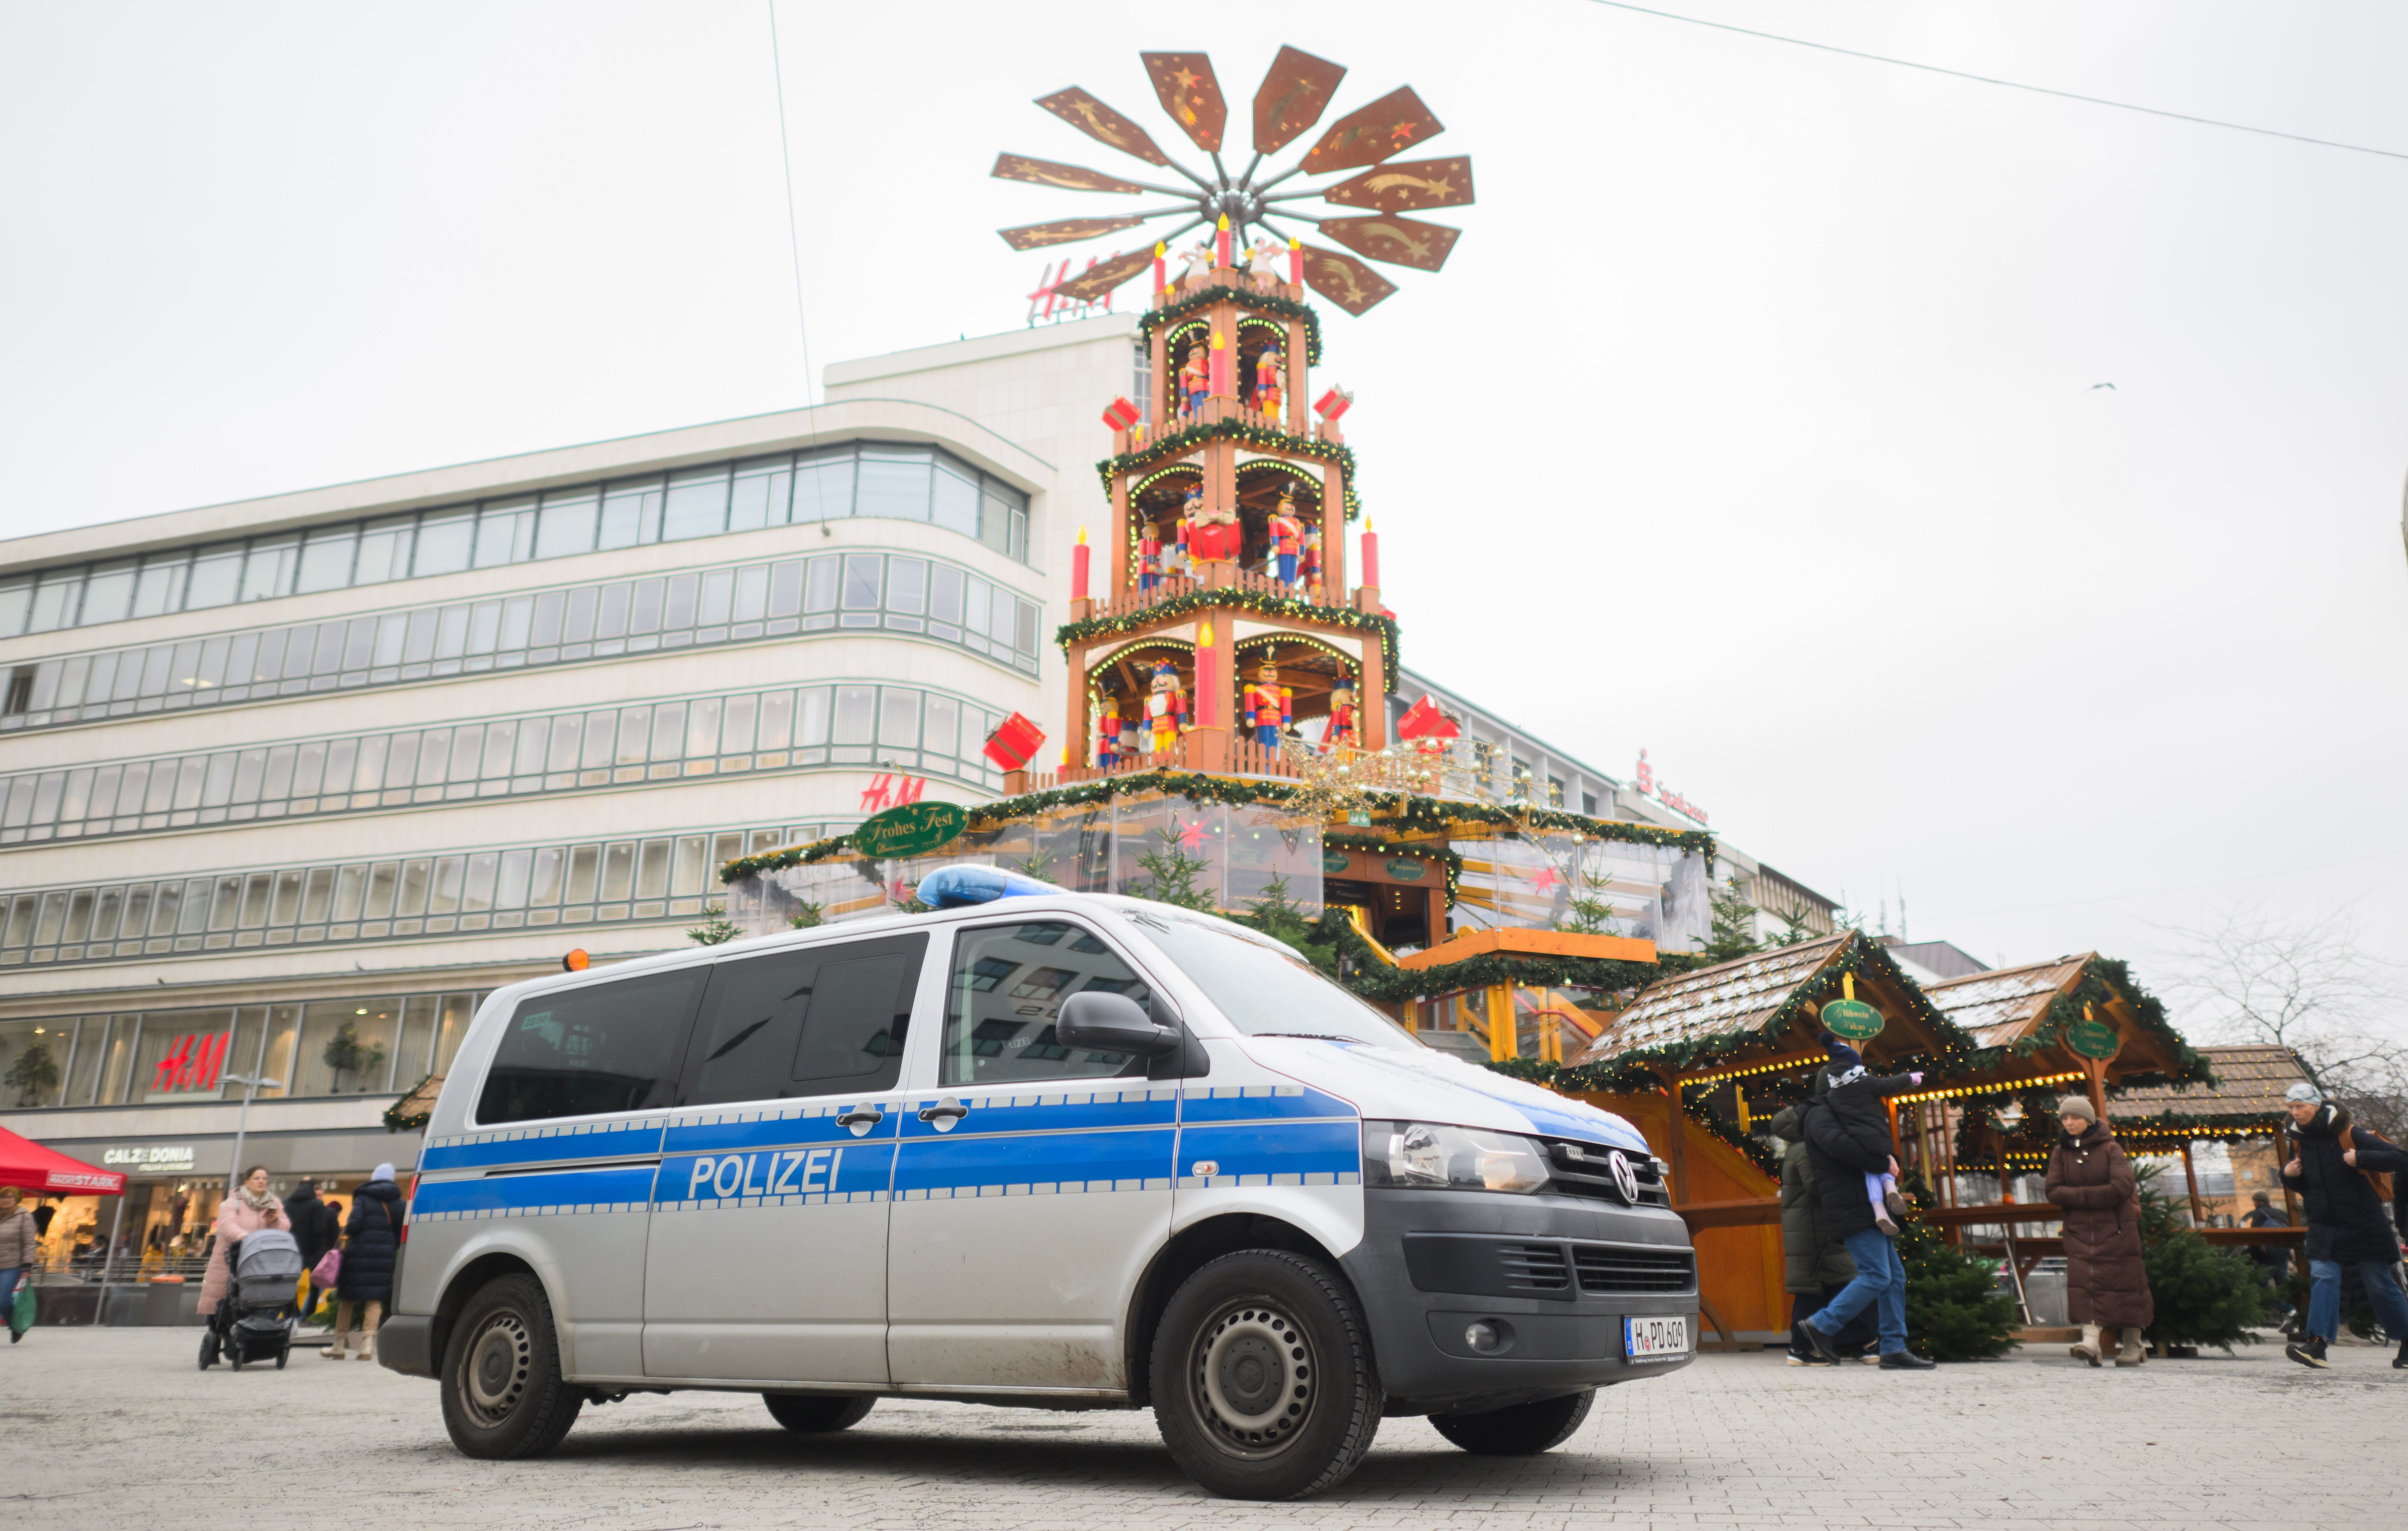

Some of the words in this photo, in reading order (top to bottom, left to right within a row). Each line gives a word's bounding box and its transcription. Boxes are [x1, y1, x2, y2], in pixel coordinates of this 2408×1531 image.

[860, 773, 926, 813] H&M
[867, 818, 915, 843] Frohes
[920, 806, 953, 832] Fest
[1834, 1006, 1869, 1019] Glühwein
[1841, 1020, 1866, 1031] Kakao
[151, 1030, 230, 1094] H&M
[104, 1146, 193, 1164] CALZEDONIA
[688, 1148, 843, 1199] POLIZEI
